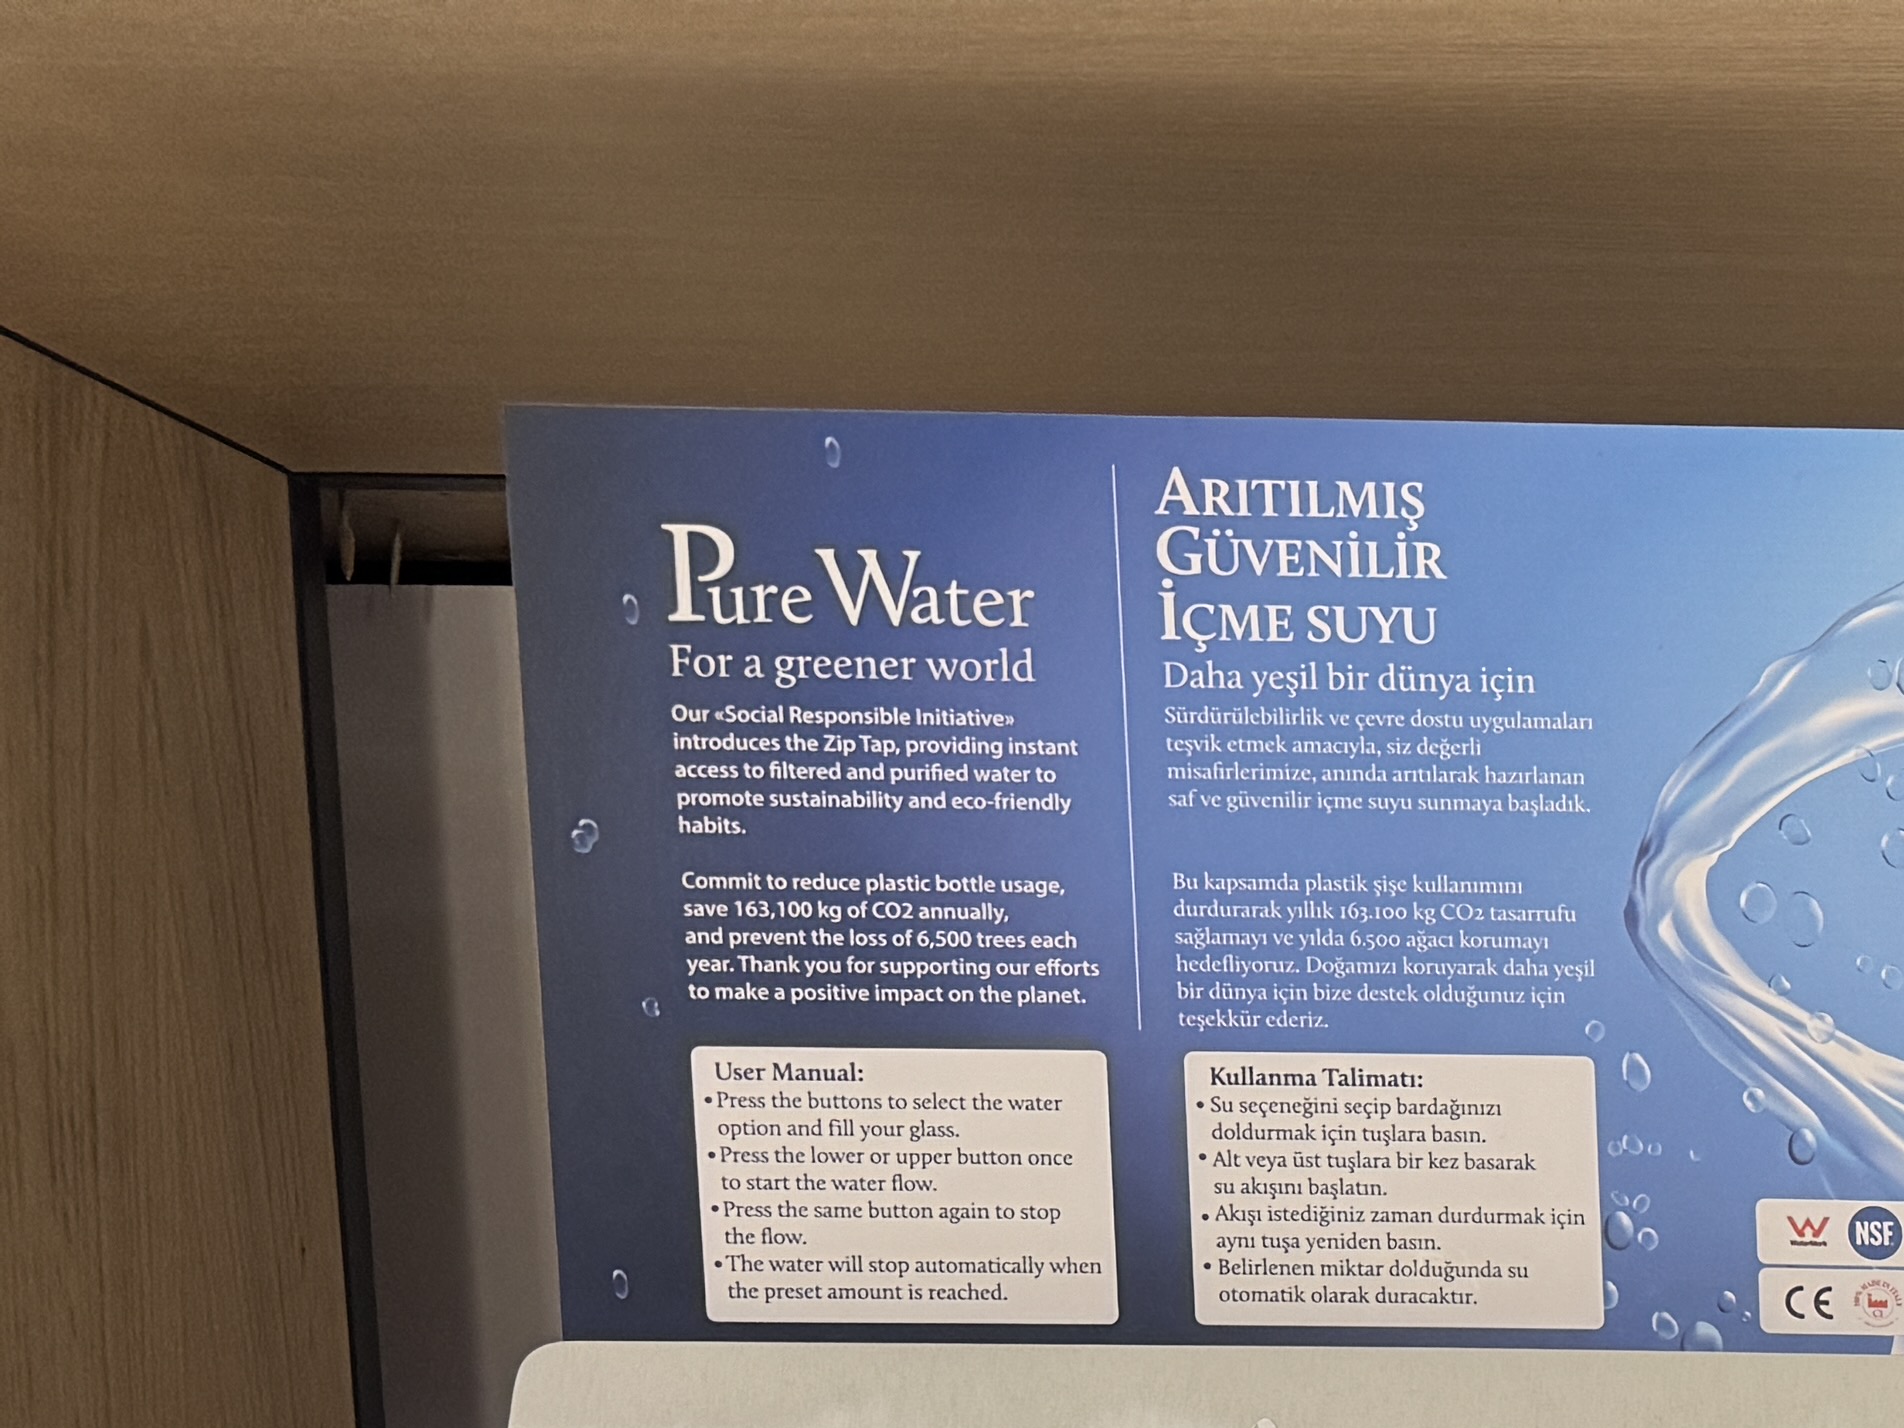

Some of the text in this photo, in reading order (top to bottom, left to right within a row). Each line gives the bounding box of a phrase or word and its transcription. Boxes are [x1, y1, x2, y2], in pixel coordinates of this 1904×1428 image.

[661, 523, 1035, 627] Pure Water
[669, 644, 1036, 689] For a greener world
[1163, 659, 1535, 702] Daha yeşil bir dünya için
[671, 703, 1015, 729] Our «Social Responsible Initiative»
[1164, 705, 1593, 734] Sürdürülebilirlik ve çevre dostu uygulamaları
[673, 731, 1078, 760] introduces the Zip Tap, providing instant
[681, 871, 1065, 898] Commit to reduce plastic bottle usage,
[683, 900, 1009, 925] save 163,100 kg of CO2 annually,
[714, 1061, 864, 1082] User Manual:
[1210, 1065, 1423, 1088] Kullanma Talimatı:
[716, 1090, 1063, 1111] Press the buttons to select the water
[1210, 1095, 1502, 1121] Su seçeneğini seçip bardağınızı
[1855, 1221, 1894, 1247] NSF
[1785, 1285, 1834, 1320] CE
